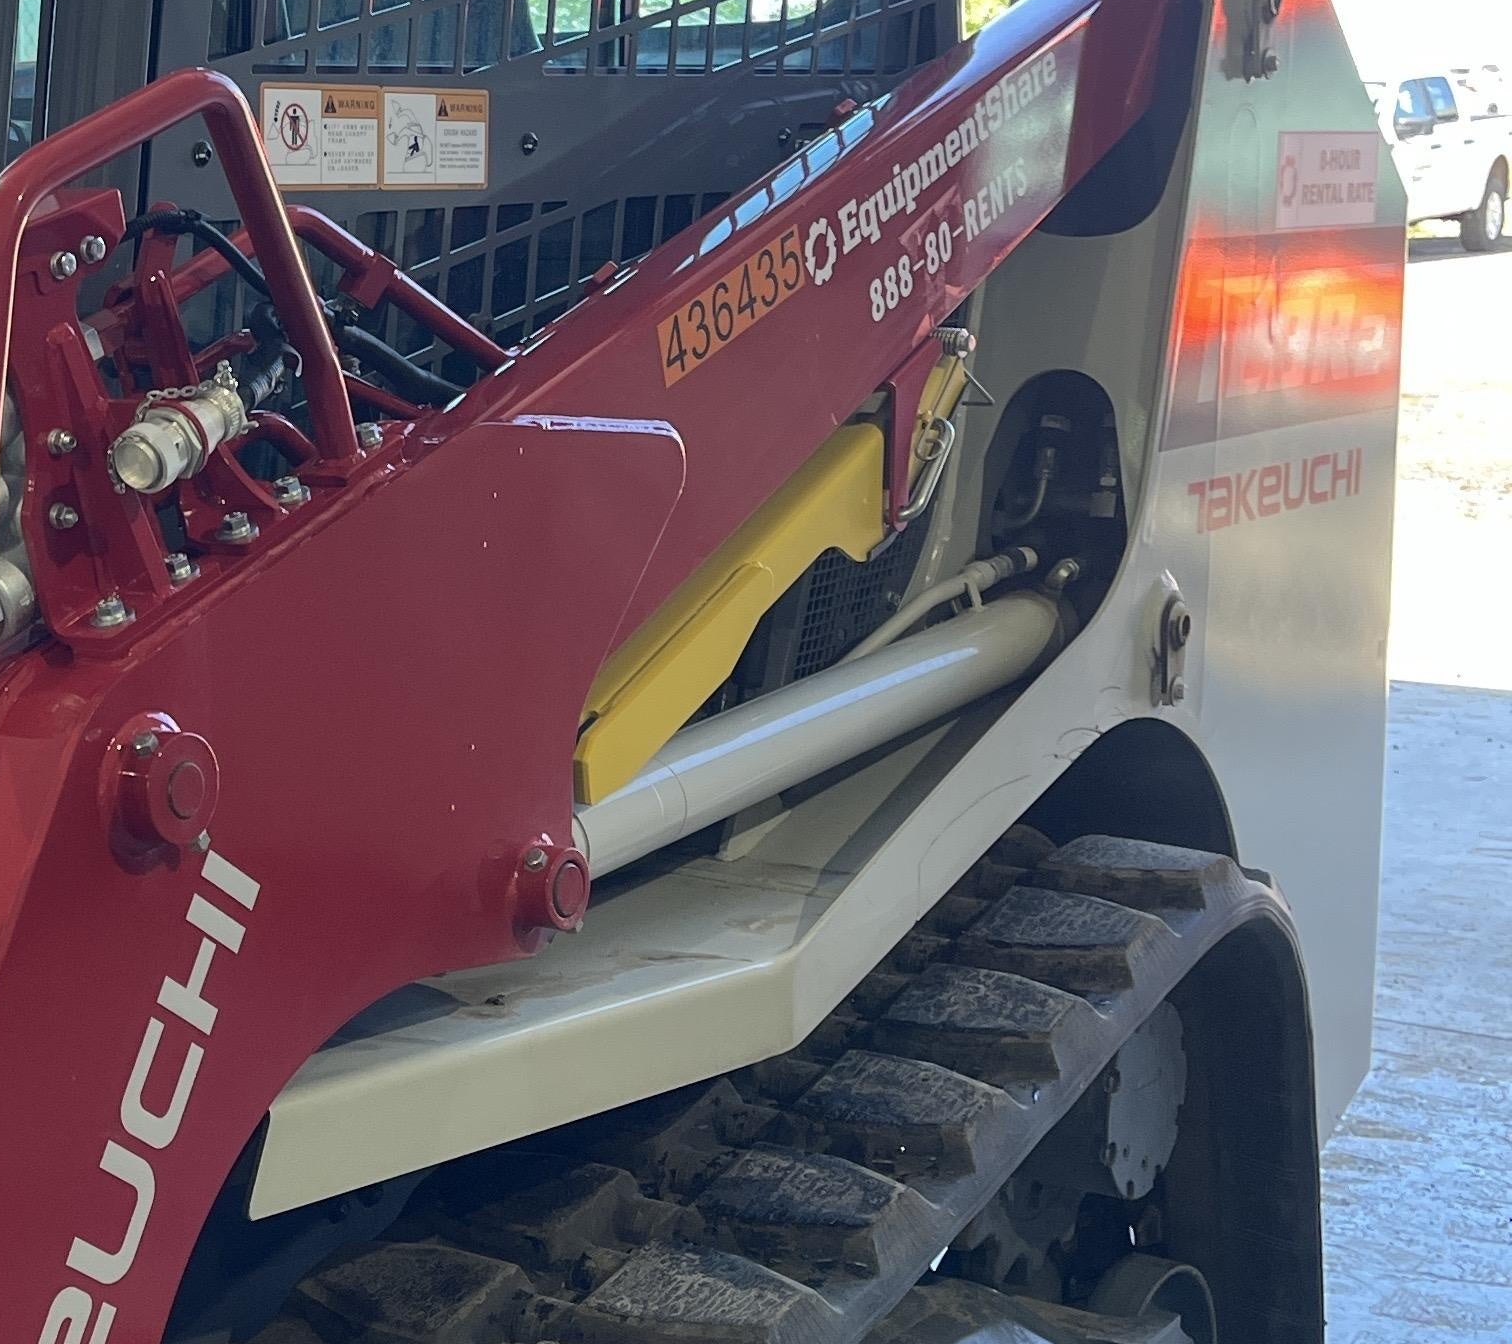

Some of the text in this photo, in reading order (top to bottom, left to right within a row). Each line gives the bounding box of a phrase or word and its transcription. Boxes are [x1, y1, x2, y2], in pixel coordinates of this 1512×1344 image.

[338, 100, 375, 110] WARNING
[450, 103, 483, 113] WARNING
[837, 51, 1058, 255] EquipmentShare
[1302, 182, 1375, 205] RENTAL RATE
[869, 157, 1029, 322] 888-80-RENTS
[665, 231, 803, 374] 436435
[1187, 447, 1363, 534] TAKEUCHI
